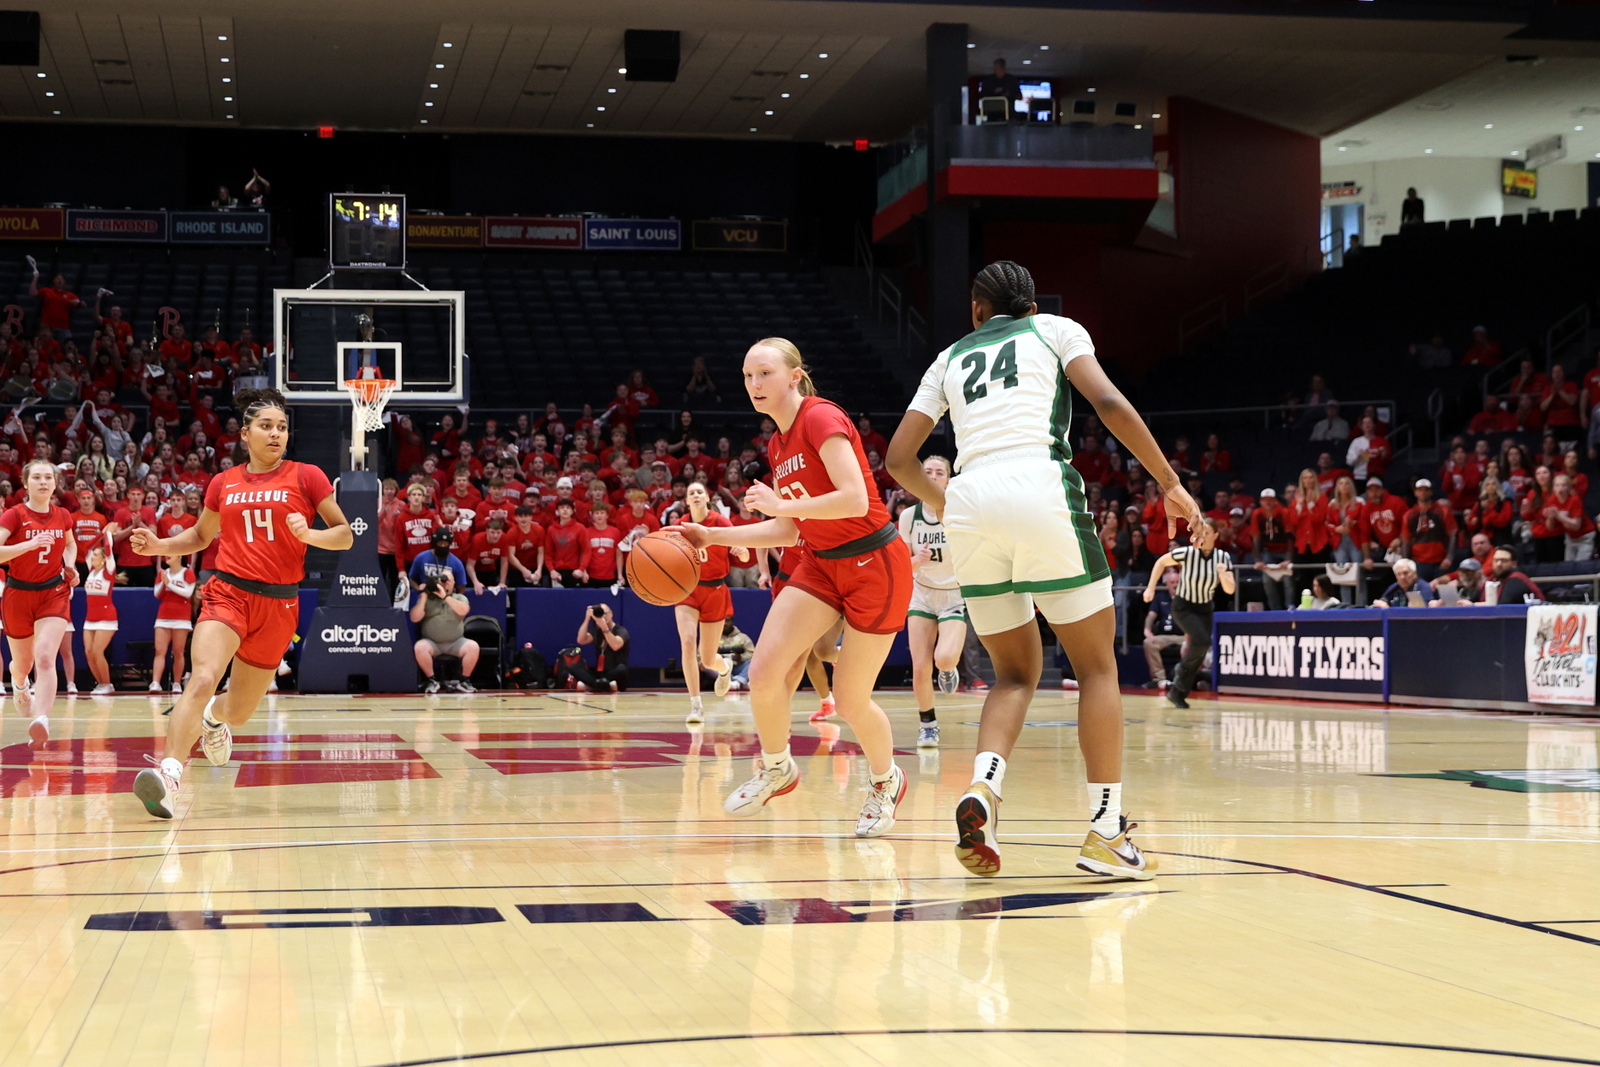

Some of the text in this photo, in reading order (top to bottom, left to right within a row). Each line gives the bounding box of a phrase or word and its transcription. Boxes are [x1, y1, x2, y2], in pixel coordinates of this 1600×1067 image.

[352, 201, 397, 221] 7:14
[0, 217, 39, 231] YOLA
[76, 218, 158, 233] RICHMOND
[176, 221, 264, 234] RHODE ISLAND
[408, 225, 479, 238] BONAVENTURE
[589, 228, 678, 240] SAINT LOUIS
[722, 229, 758, 242] VCU
[961, 339, 1019, 406] 24
[225, 490, 289, 506] BELLEVUE
[241, 508, 275, 543] 14
[917, 531, 947, 545] LAURE
[38, 542, 52, 564] 2
[929, 547, 943, 563] 21
[339, 574, 379, 585] Premier
[342, 585, 377, 596] Health
[320, 624, 399, 646] altafiber
[328, 645, 393, 654] connecting dayton
[1218, 634, 1385, 681] DAYTON FLYERS
